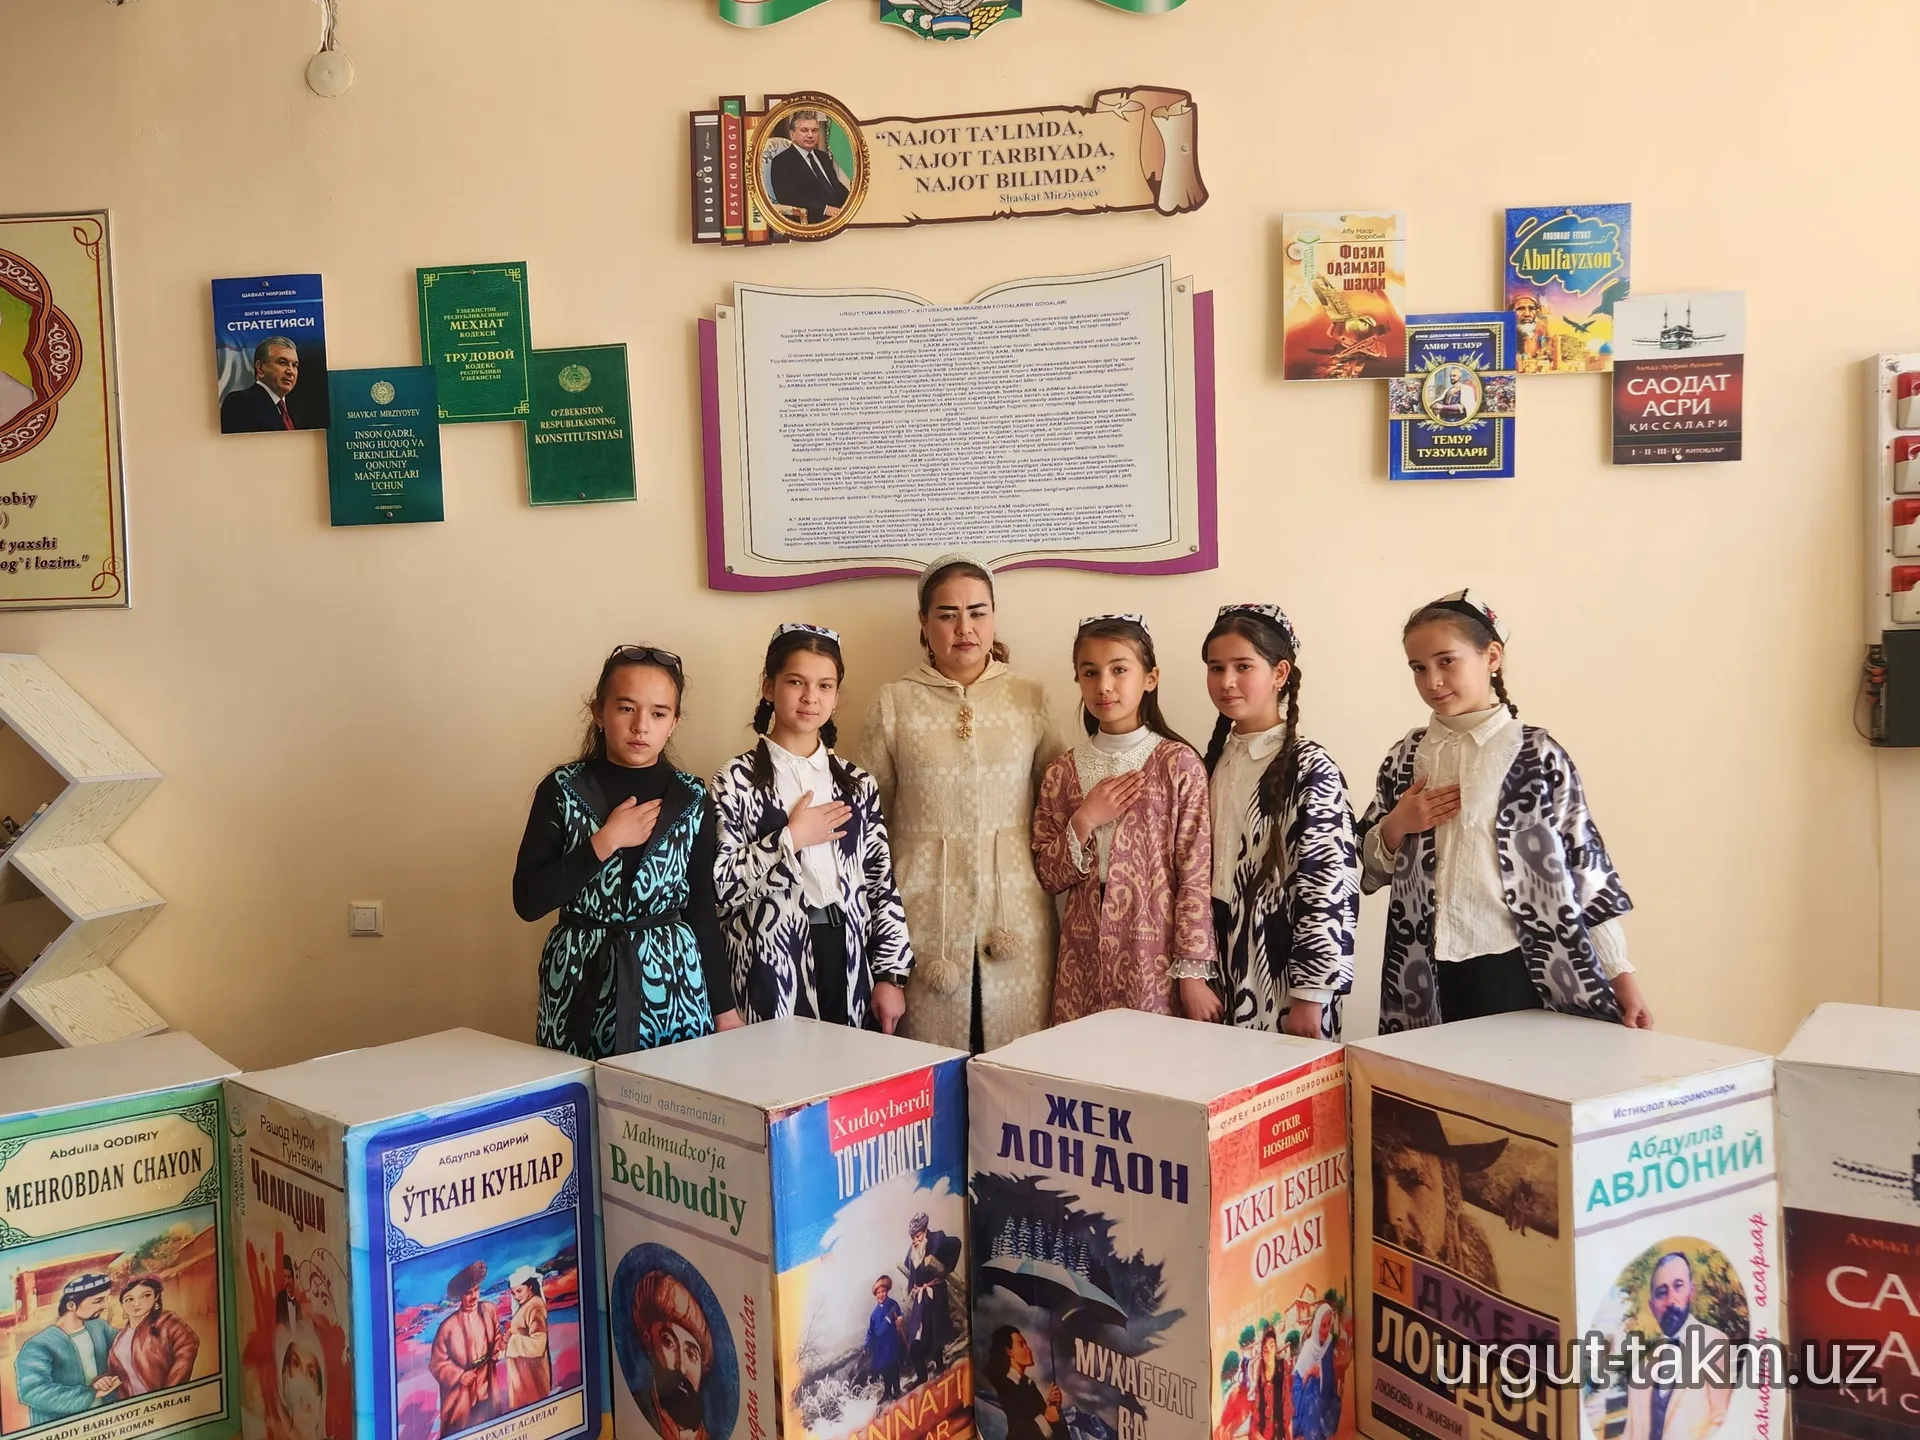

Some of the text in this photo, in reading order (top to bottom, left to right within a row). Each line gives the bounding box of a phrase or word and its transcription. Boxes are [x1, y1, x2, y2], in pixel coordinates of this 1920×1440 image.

[875, 127, 961, 147] “NAJOT
[899, 141, 1115, 170] NAJOT TARBIYADA,
[728, 123, 739, 217] PSYCHOLOGY
[915, 165, 1107, 193] NAJOT BILIMDA”
[703, 154, 714, 224] BIOLOGY
[1000, 188, 1100, 203] Shavkat Mirziyoyev
[752, 204, 762, 224] PHY
[1356, 228, 1374, 236] Наср
[1340, 244, 1385, 260] Фозил
[1521, 247, 1612, 275] Abulfayzxon
[1327, 261, 1386, 277] одамлар
[241, 291, 266, 299] ШАВКАТ
[227, 317, 315, 332] СТРАТЕГИЯСИ
[459, 330, 496, 338] КОДЕКСИ
[444, 349, 515, 363] ТРУДОВОЙ
[1451, 342, 1482, 350] ТЕМУР
[459, 368, 502, 376] РЕСПУБЛИКИ
[465, 362, 496, 370] КОДЕКС
[1627, 374, 1732, 397] САОДАТ
[347, 409, 420, 419] SHAVKAT MIRZIYOYEV
[1642, 398, 1711, 417] АСРИ
[355, 429, 415, 440] INSON QADRI,
[540, 417, 616, 429] RESPUBLIKASINING
[1629, 420, 1728, 433] ҚИССАЛАРИ
[346, 439, 425, 450] UNING HUQUQ VA
[534, 429, 624, 444] KONSTITUTSIYASI
[1432, 434, 1472, 445] ТЕМУР
[353, 449, 419, 460] ERKINLIKLARI,
[1417, 447, 1488, 458] ТУЗУКЛАРИ
[354, 470, 419, 481] MANFAATLARI
[365, 460, 407, 470] QONUNIY
[371, 481, 404, 490] UCHUN
[0, 491, 39, 509] obiy
[9, 536, 59, 556] yaxshi
[0, 556, 31, 575] og`i
[620, 1085, 727, 1127] Istiqlol qahramonlari
[833, 1088, 931, 1140] Xudoyberdi
[1251, 1091, 1294, 1114] ADABIYOTI
[1613, 1098, 1665, 1120] Истиқлол
[1044, 1092, 1134, 1145] ЖЕК
[260, 1113, 316, 1152] Рашод Нури
[1262, 1126, 1311, 1159] HOSHIMOV
[1627, 1123, 1724, 1163] Абдулла
[49, 1129, 160, 1160] Abdulla QODIRIY
[282, 1142, 323, 1175] Гунтекин
[438, 1147, 481, 1167] Абдулла
[996, 1121, 1190, 1206] ЛОНДОН
[5, 1147, 203, 1213] MEHROBDAN CHAYON
[238, 1143, 246, 1217] KUTUBXONASI
[1586, 1129, 1764, 1213] АВЛОНИЙ
[401, 1150, 564, 1224] ЎТКАН КУНЛАР
[608, 1142, 748, 1237] Behbudiy
[1223, 1151, 1347, 1244] IKKI ESHIK
[1255, 1215, 1324, 1279] ORASI
[1749, 1211, 1770, 1308] асарлар
[1826, 1265, 1920, 1318] СА
[1417, 1272, 1556, 1355] ДЖЕК
[738, 1294, 757, 1380] asarlar
[1871, 1331, 1920, 1378] А
[1074, 1336, 1197, 1420] МУҲАББАТ
[40, 1394, 192, 1440] BADIY BARHAYOT ASARLAR
[518, 1406, 559, 1430] АСАРЛАР
[1375, 1377, 1413, 1410] ЛЮБОВЬ
[1416, 1401, 1424, 1416] К
[1426, 1407, 1463, 1437] ЖИЗНИ
[86, 1417, 155, 1440] RIXIY ROMAN
[923, 1419, 952, 1440] AR
[1118, 1404, 1148, 1440] ВА
